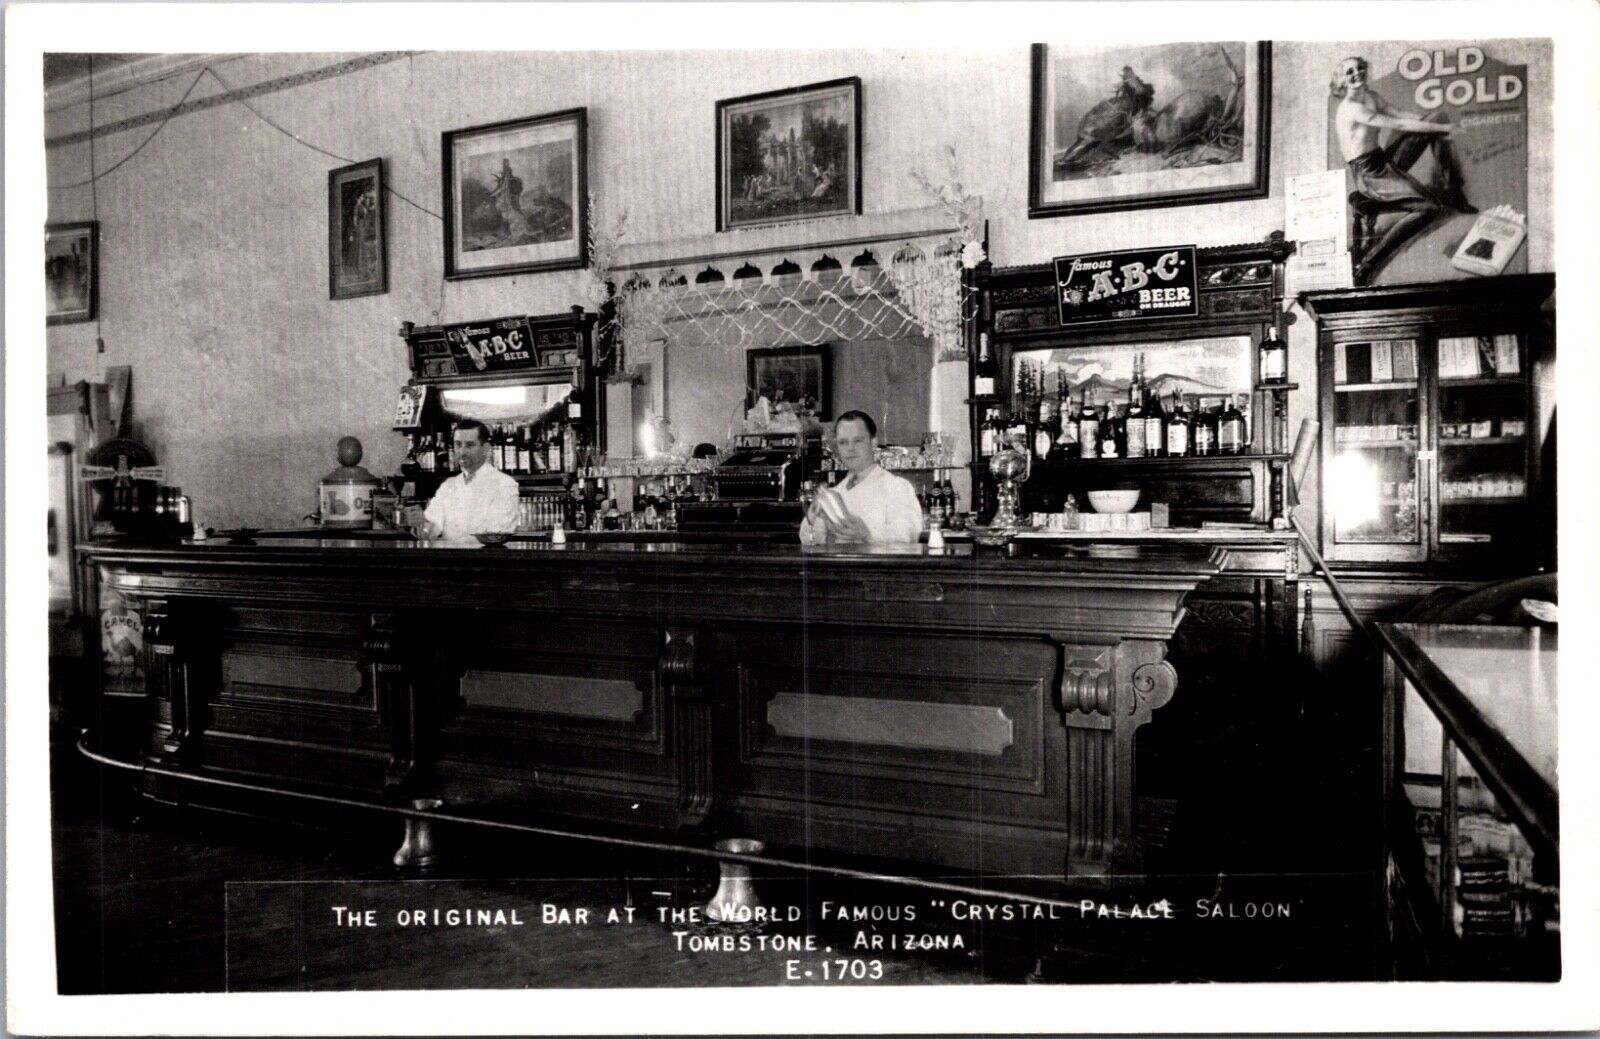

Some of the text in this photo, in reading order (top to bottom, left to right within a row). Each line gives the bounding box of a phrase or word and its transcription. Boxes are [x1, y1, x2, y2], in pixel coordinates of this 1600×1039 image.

[1398, 47, 1485, 80] OLD
[1414, 74, 1523, 110] GOLD
[1059, 259, 1113, 287] famous
[1138, 286, 1191, 303] BEER
[1152, 300, 1191, 309] DRAUGHT
[503, 351, 530, 361] BEER
[104, 617, 140, 632] CAMEL
